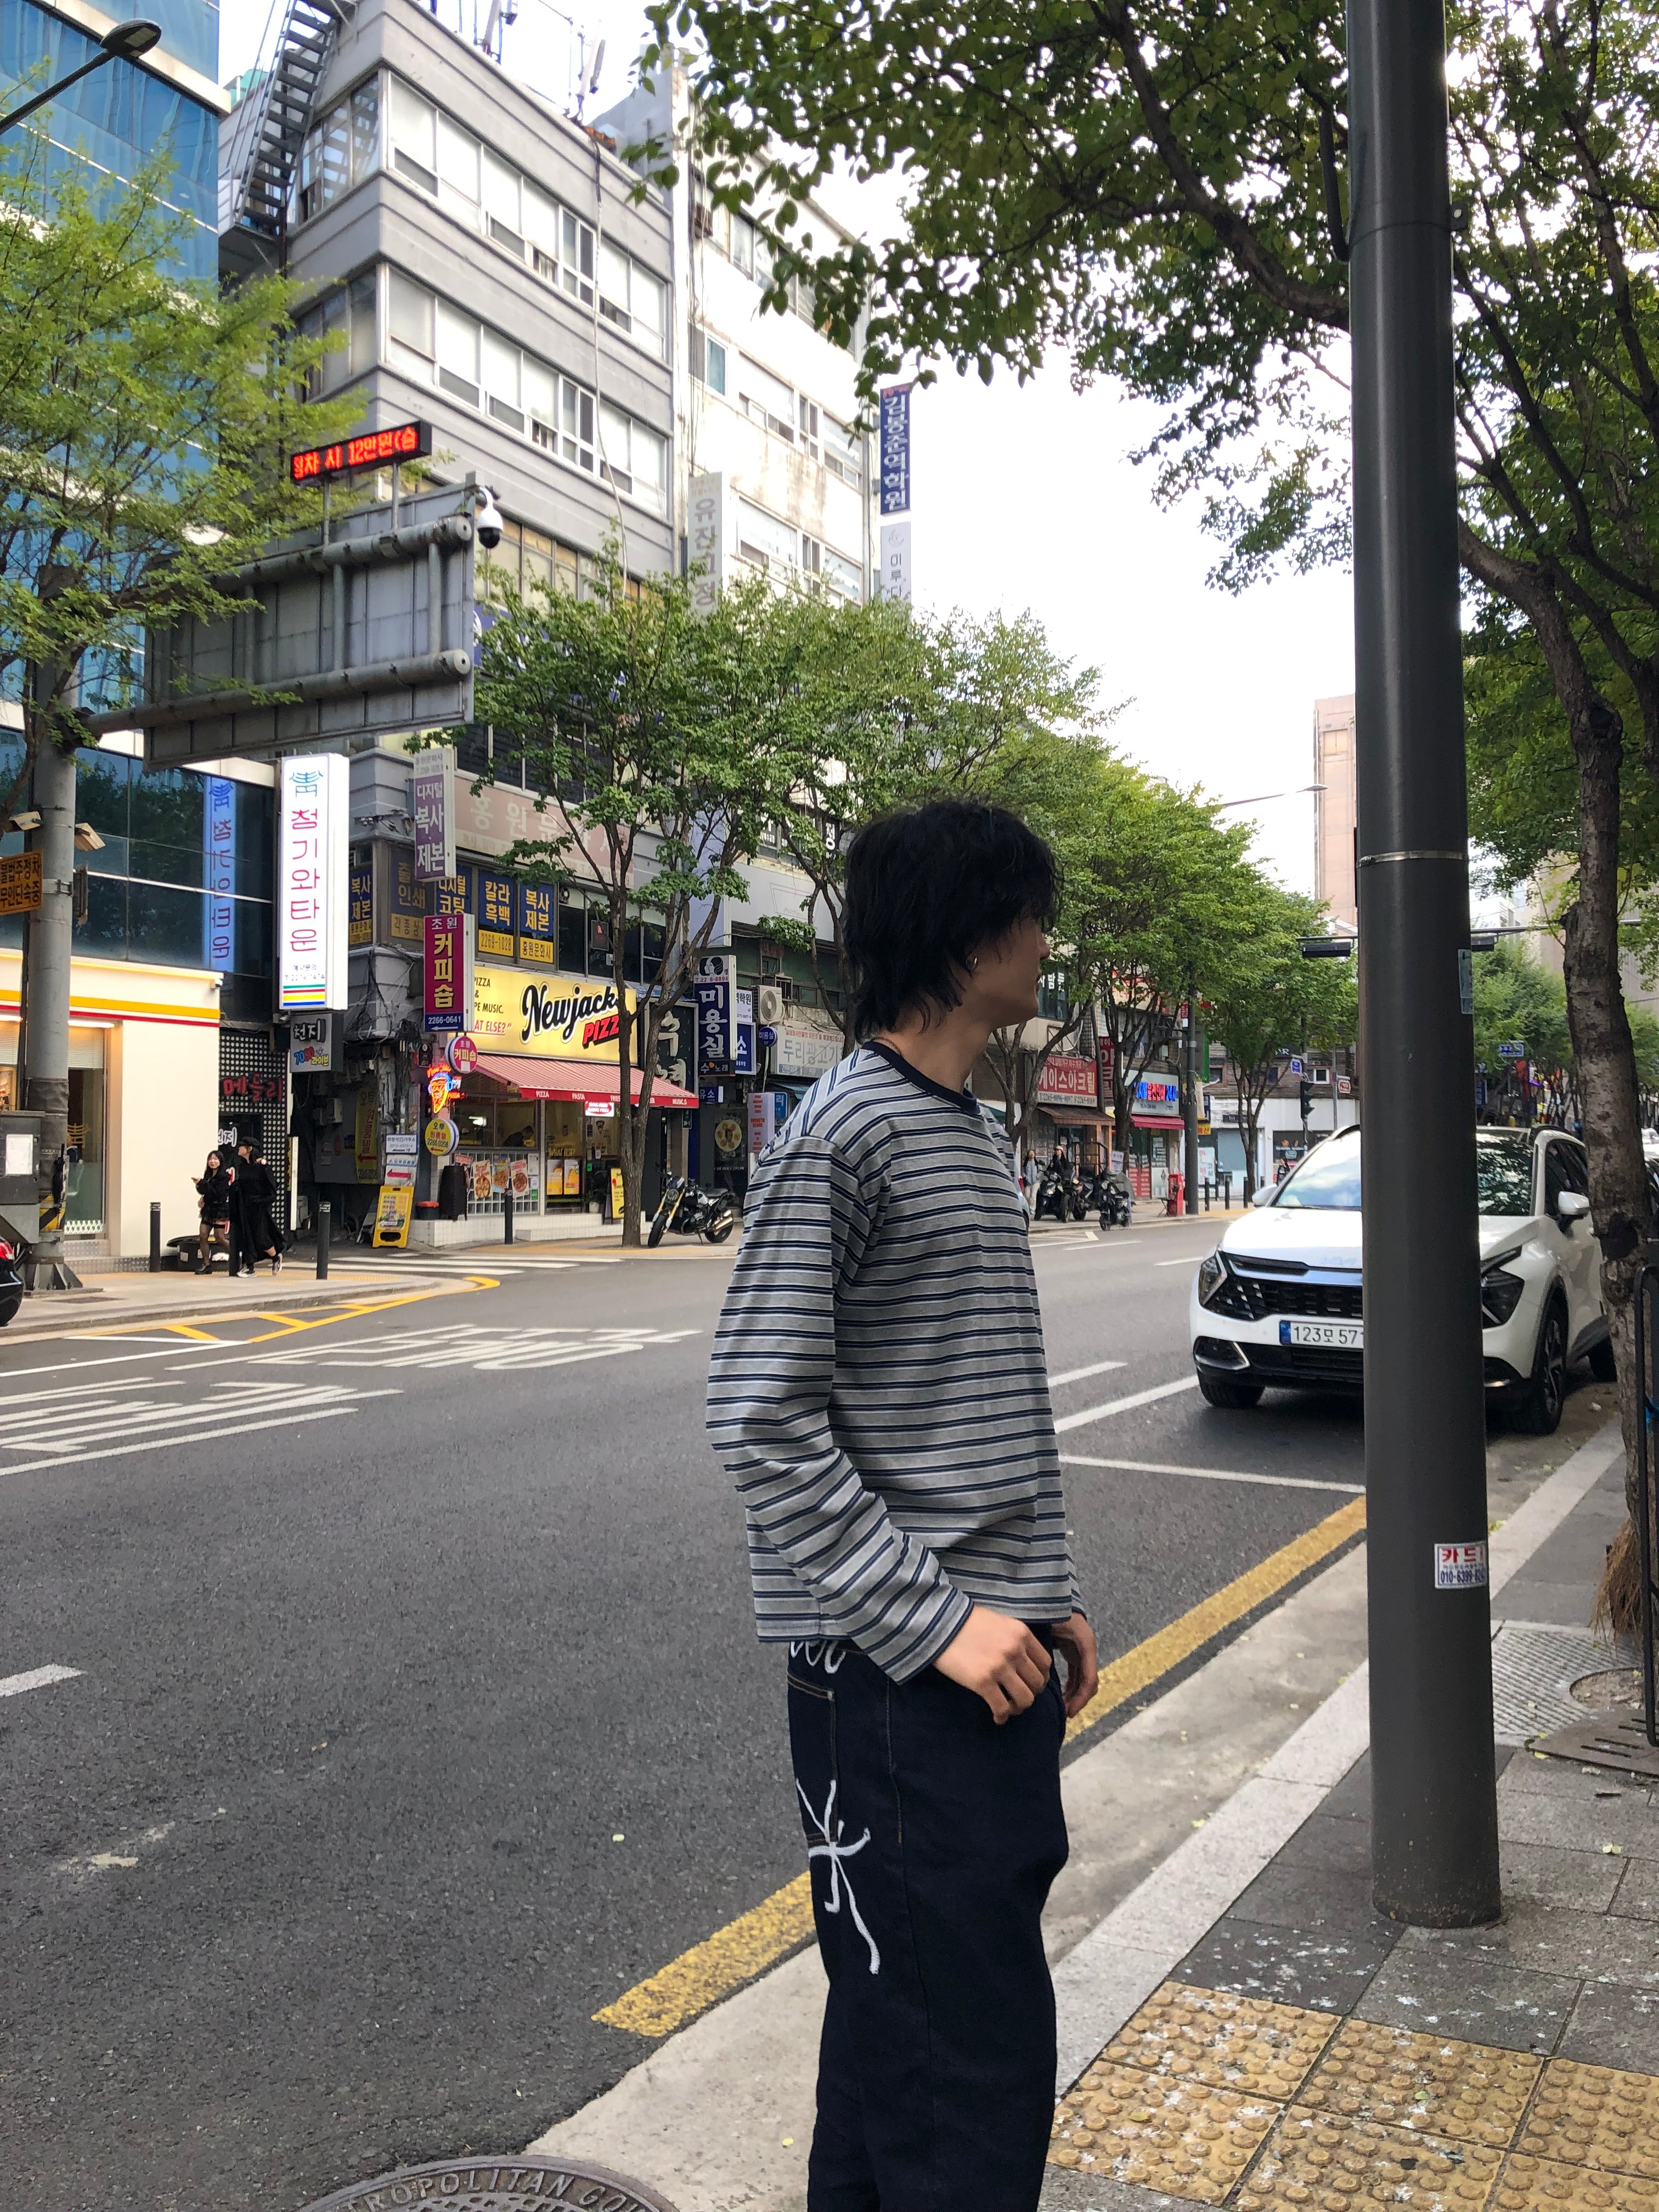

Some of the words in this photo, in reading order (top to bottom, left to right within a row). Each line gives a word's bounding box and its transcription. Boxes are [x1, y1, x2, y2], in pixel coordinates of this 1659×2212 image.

[325, 445, 342, 469] 시
[417, 781, 443, 800] 디지털
[417, 803, 444, 834] 복사
[417, 842, 444, 872] 제본
[351, 874, 371, 895] 복사
[485, 881, 510, 904] 칼라
[398, 884, 426, 909] 인쇄
[439, 895, 465, 915] 코팅
[525, 889, 550, 912] 복사
[351, 899, 371, 920] 제본
[486, 904, 510, 926] 흑백
[431, 917, 458, 930] 조원
[525, 910, 550, 932] 제본
[481, 933, 511, 951] 2269-1028
[522, 940, 551, 960] 홍원문화사
[434, 933, 454, 1008] 커피숍
[475, 990, 479, 998] &
[428, 1016, 461, 1024] 2266-0641
[521, 984, 619, 1042] Newjack
[699, 985, 728, 1058] 미용실
[294, 1020, 321, 1041] 천지
[582, 1014, 619, 1046] PIZZ
[759, 1031, 775, 1040] 미용실
[311, 1054, 329, 1066] 라이브
[454, 1048, 476, 1062] 커피숍
[223, 1073, 283, 1102] 메들리
[535, 1090, 550, 1098] PIZZA
[572, 1092, 586, 1101] PASTA
[699, 1088, 715, 1100] 유소
[1294, 1325, 1334, 1343] 123모
[1339, 1329, 1364, 1345] 57
[1441, 1546, 1485, 1564] 카드
